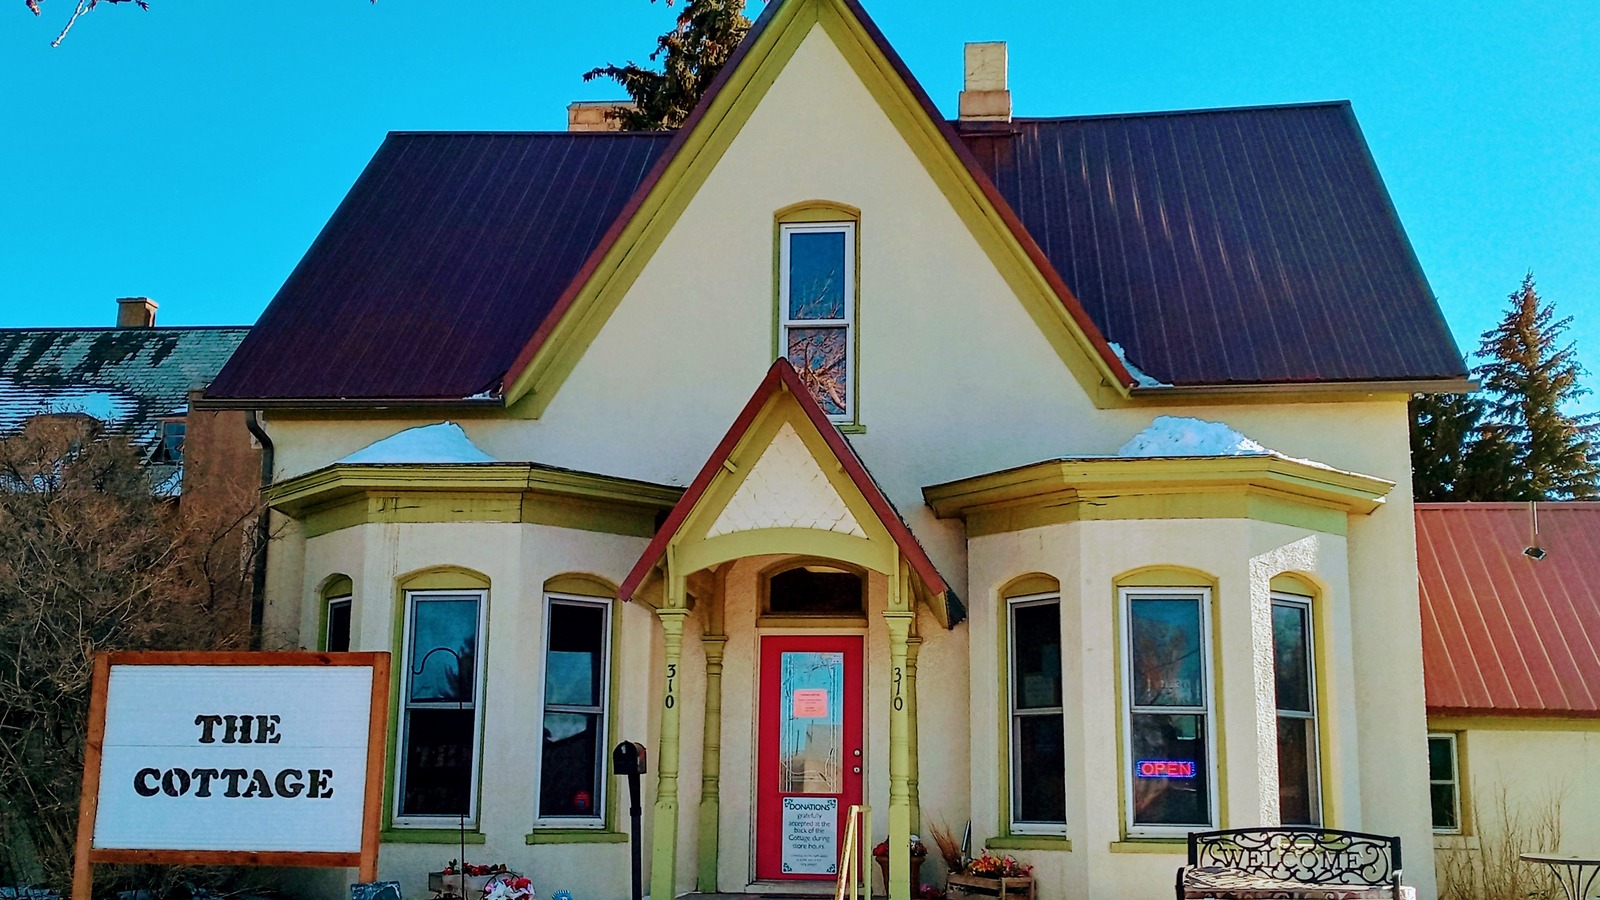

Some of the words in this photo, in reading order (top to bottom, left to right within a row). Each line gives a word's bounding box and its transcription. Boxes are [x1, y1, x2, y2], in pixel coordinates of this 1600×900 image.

[665, 664, 677, 709] 310
[893, 667, 903, 711] 310
[194, 714, 281, 744] THE
[1141, 763, 1191, 775] OPEN
[133, 767, 334, 799] COTTAGE
[789, 803, 831, 811] DONATIONS
[788, 834, 811, 842] Cottage
[812, 835, 830, 843] during
[1222, 849, 1363, 871] WELCOME
